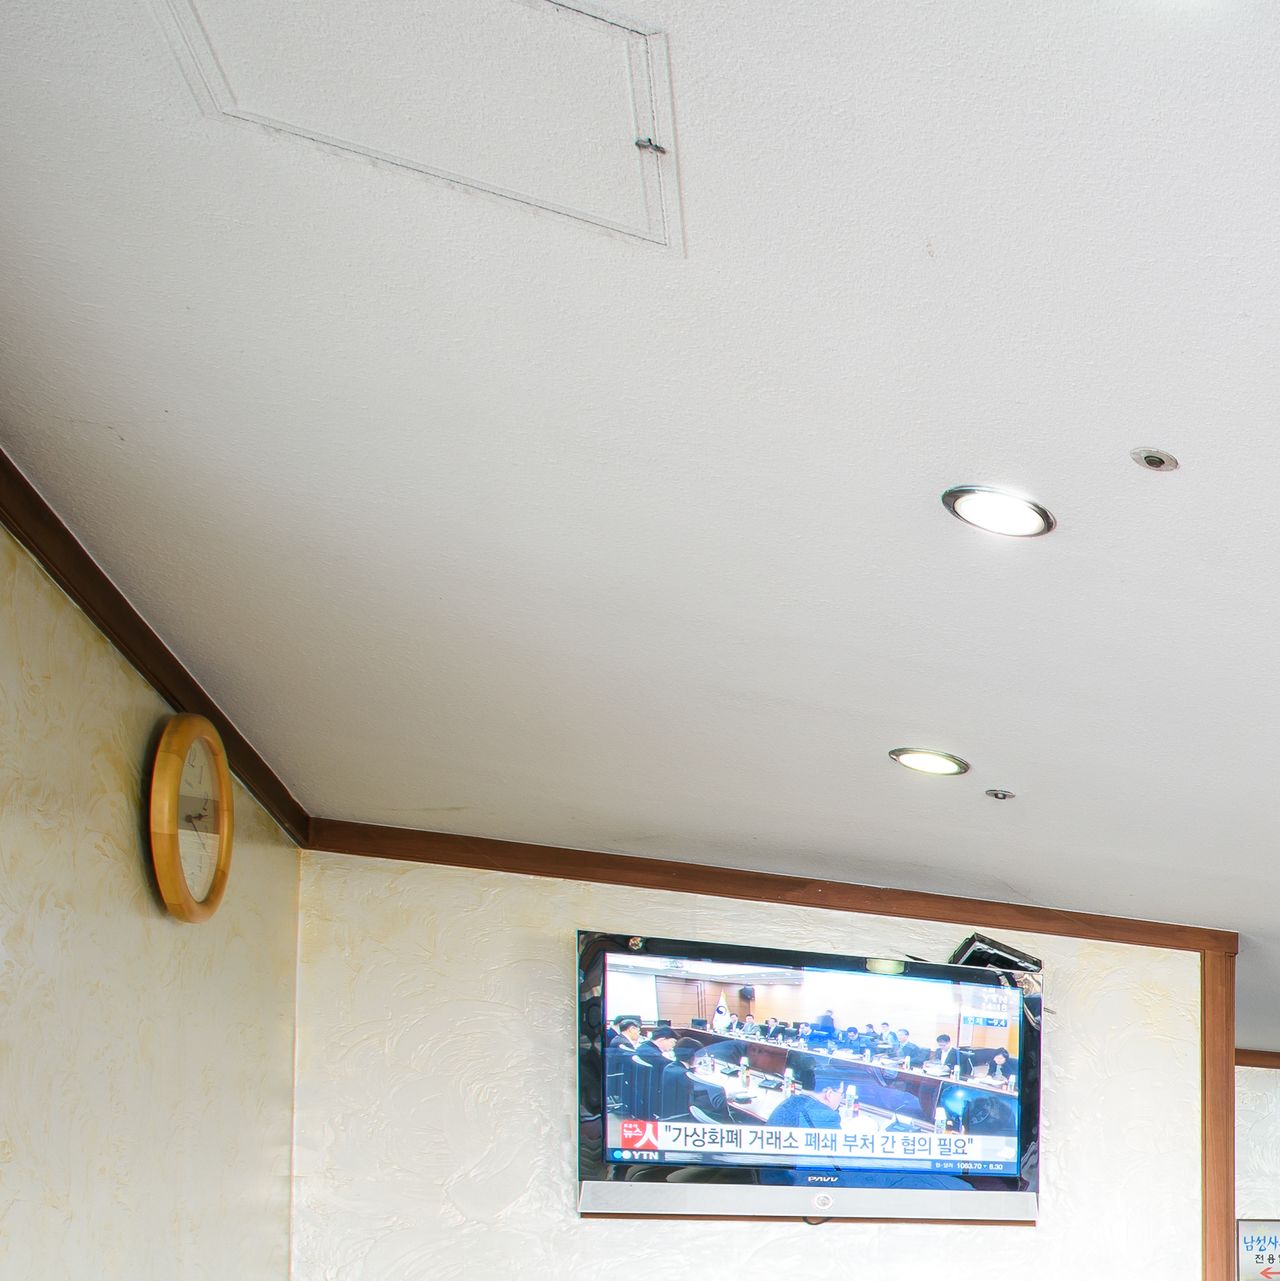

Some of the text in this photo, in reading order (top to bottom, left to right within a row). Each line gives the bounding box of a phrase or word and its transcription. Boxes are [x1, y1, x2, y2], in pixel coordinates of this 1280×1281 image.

[665, 1125, 973, 1156] "가상화폐 거래소 폐쇄 부처 간 협의 필요"
[632, 1151, 660, 1160] YTN
